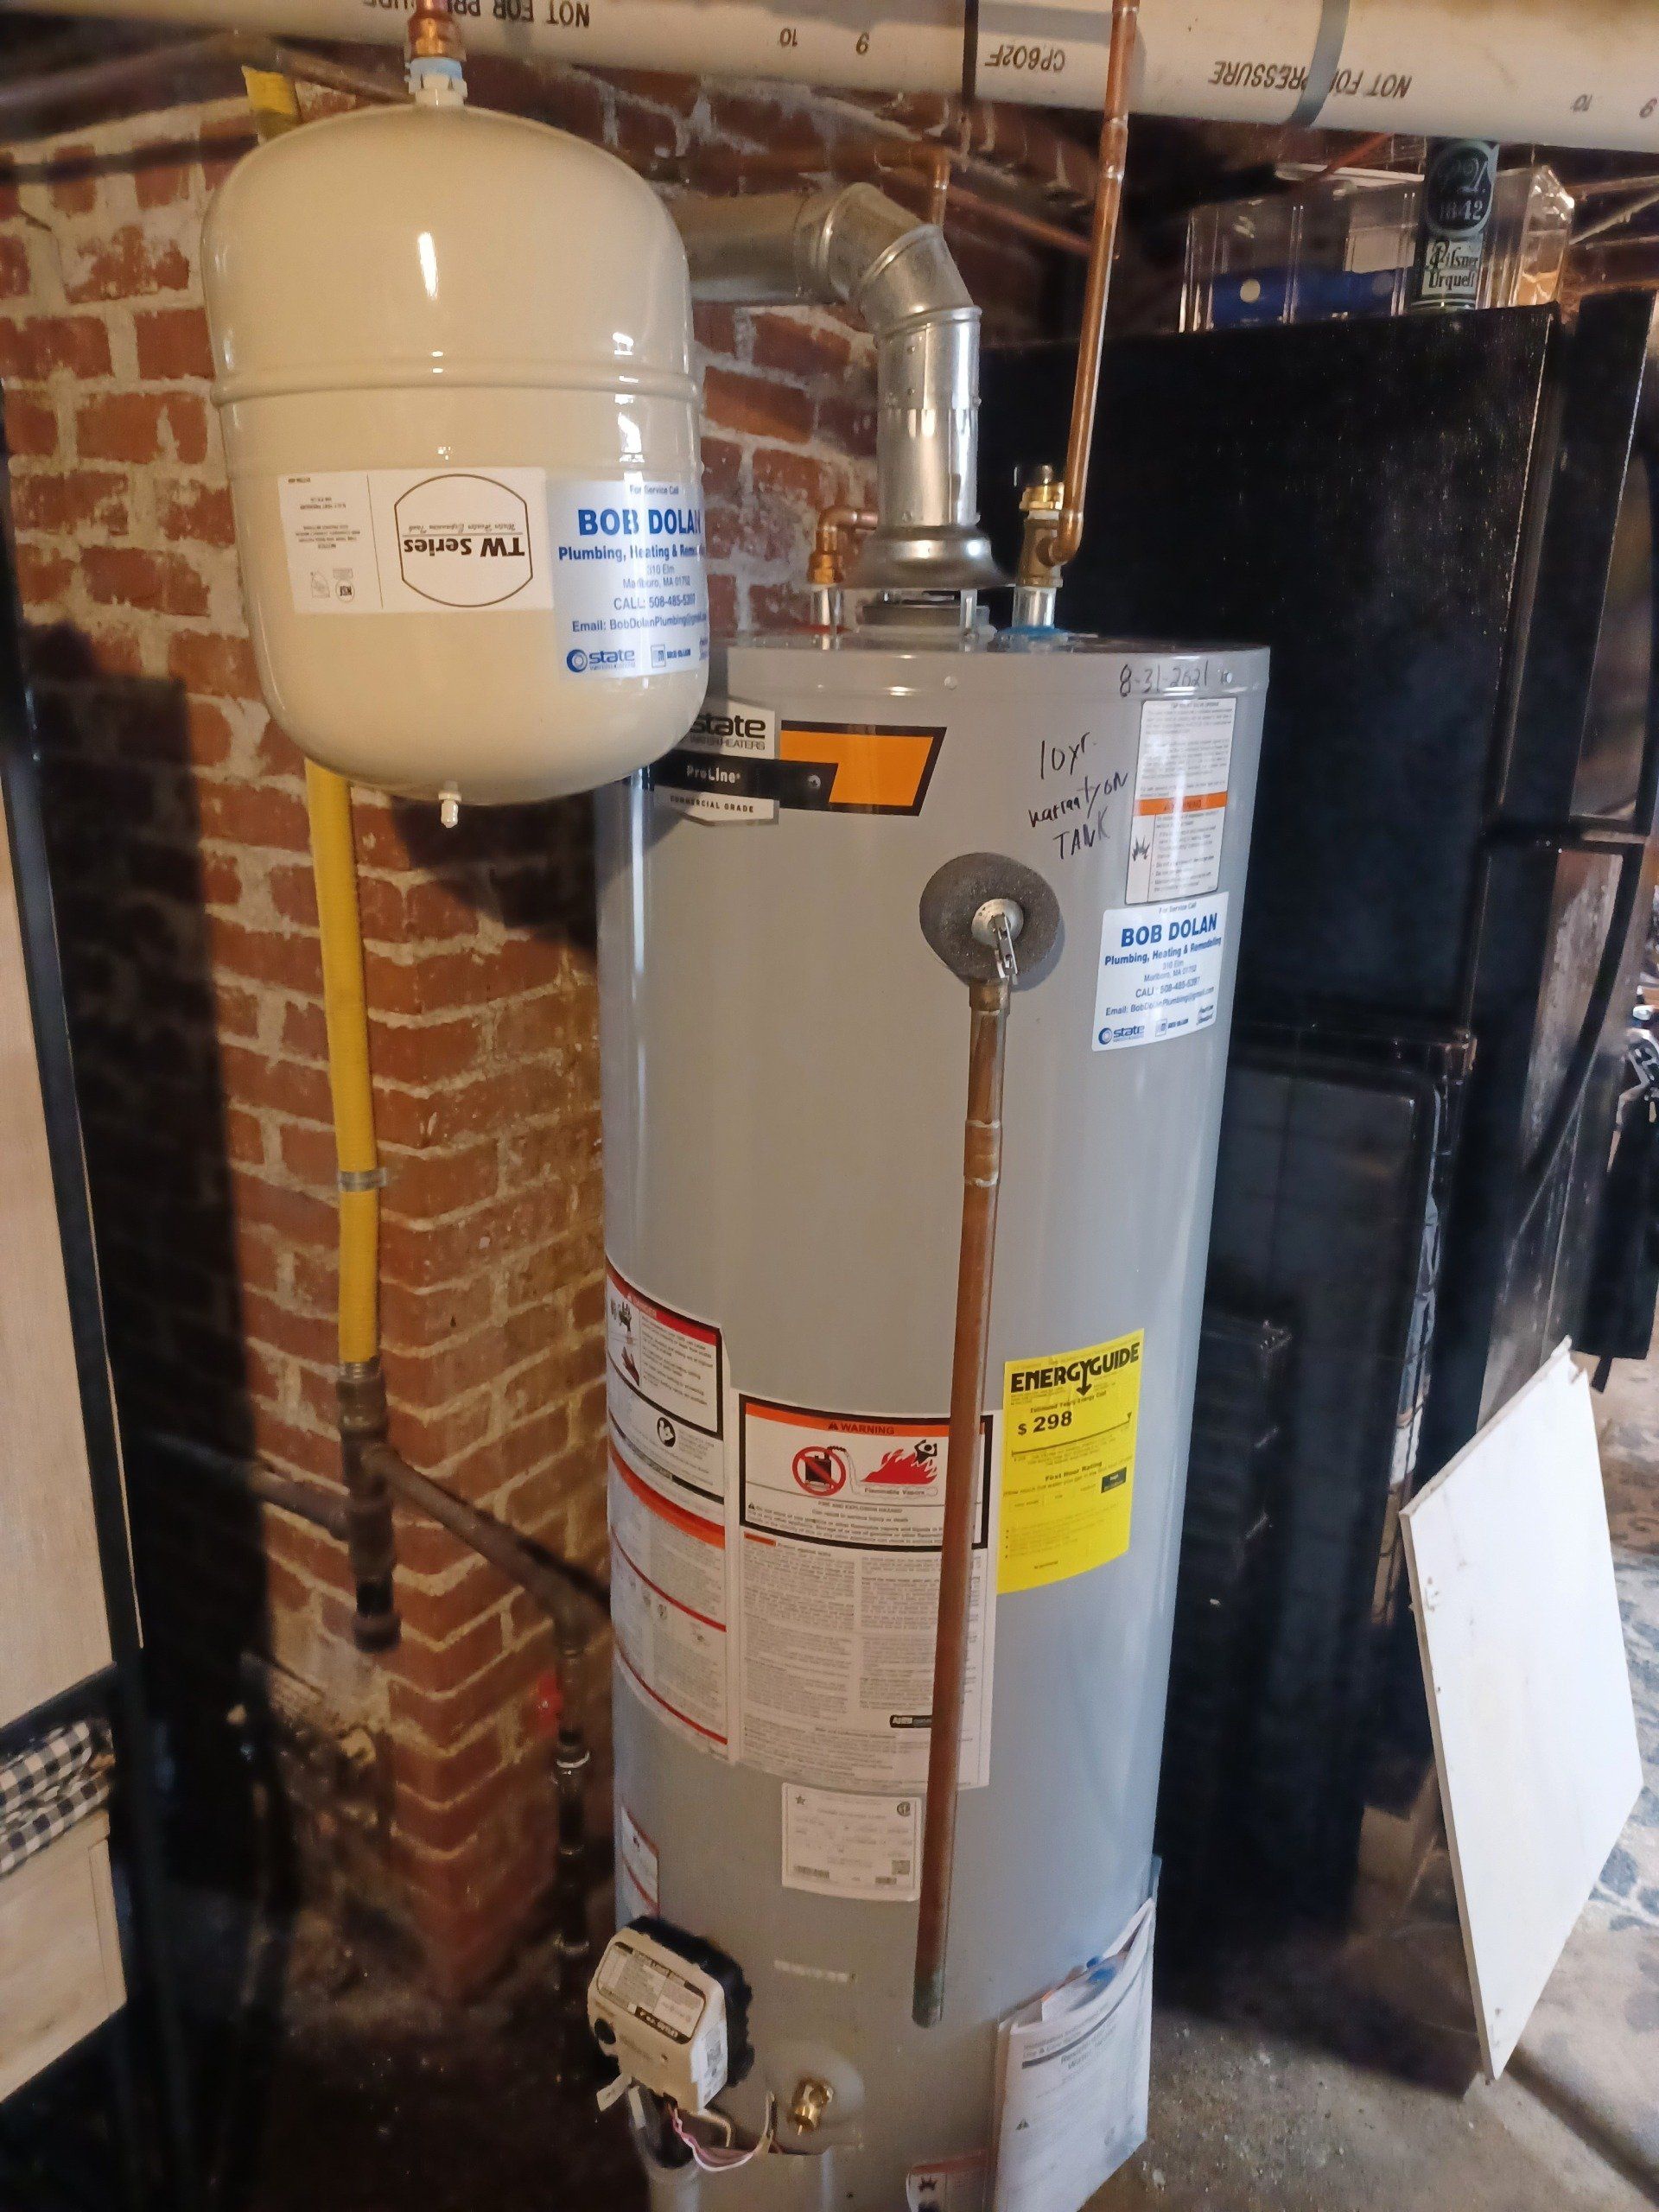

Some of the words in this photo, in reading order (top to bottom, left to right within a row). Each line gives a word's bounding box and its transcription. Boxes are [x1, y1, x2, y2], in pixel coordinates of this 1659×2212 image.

[491, 0, 535, 23] FOR
[546, 0, 590, 29] NOT
[779, 28, 798, 48] 10
[985, 45, 1065, 73] CP602F
[1364, 73, 1413, 99] NOT
[1428, 239, 1478, 270] Pilsner
[1428, 268, 1475, 291] Urquell
[578, 508, 639, 536] BOB
[404, 537, 472, 557] Series
[480, 537, 524, 557] TW
[558, 545, 626, 563] Plumbing,
[671, 544, 677, 557] &
[572, 620, 606, 632] Email:
[588, 649, 635, 664] state
[1121, 925, 1162, 948] BOB
[1169, 912, 1217, 941] DOLAN
[1104, 951, 1149, 966] Plumbing,
[1152, 946, 1181, 961] Heating
[1183, 944, 1188, 955] &
[1113, 1024, 1146, 1038] state
[1011, 1342, 1141, 1395] ENERGYGUIDE
[841, 1423, 894, 1436] WARNING
[1017, 1422, 1027, 1436] $
[1033, 1410, 1073, 1433] 298
